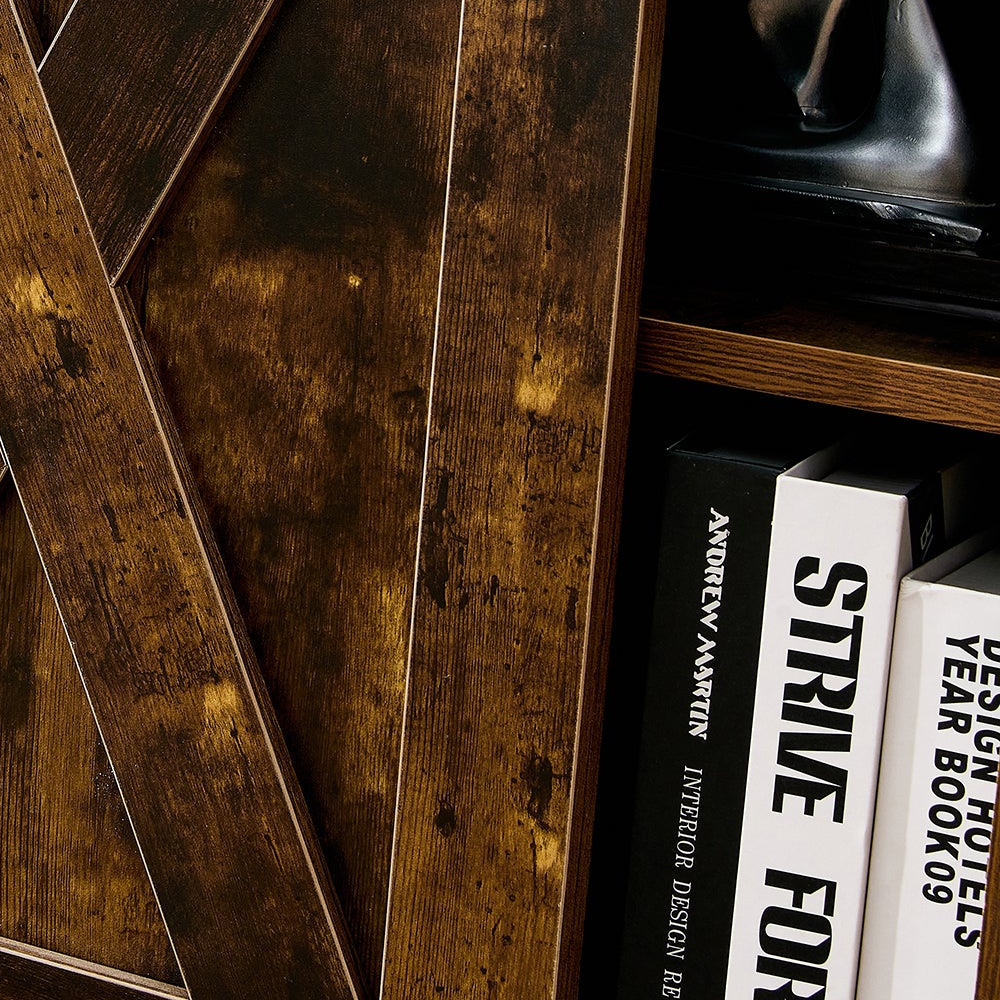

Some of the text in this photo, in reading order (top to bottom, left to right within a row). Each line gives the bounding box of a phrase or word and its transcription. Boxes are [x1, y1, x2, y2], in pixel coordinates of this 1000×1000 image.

[689, 507, 730, 740] ANDREW MARTIN
[937, 635, 980, 735] YEAR
[674, 765, 703, 869] INTERIOR
[753, 555, 868, 1000] STRIVE FOR
[666, 879, 692, 960] DESIGN
